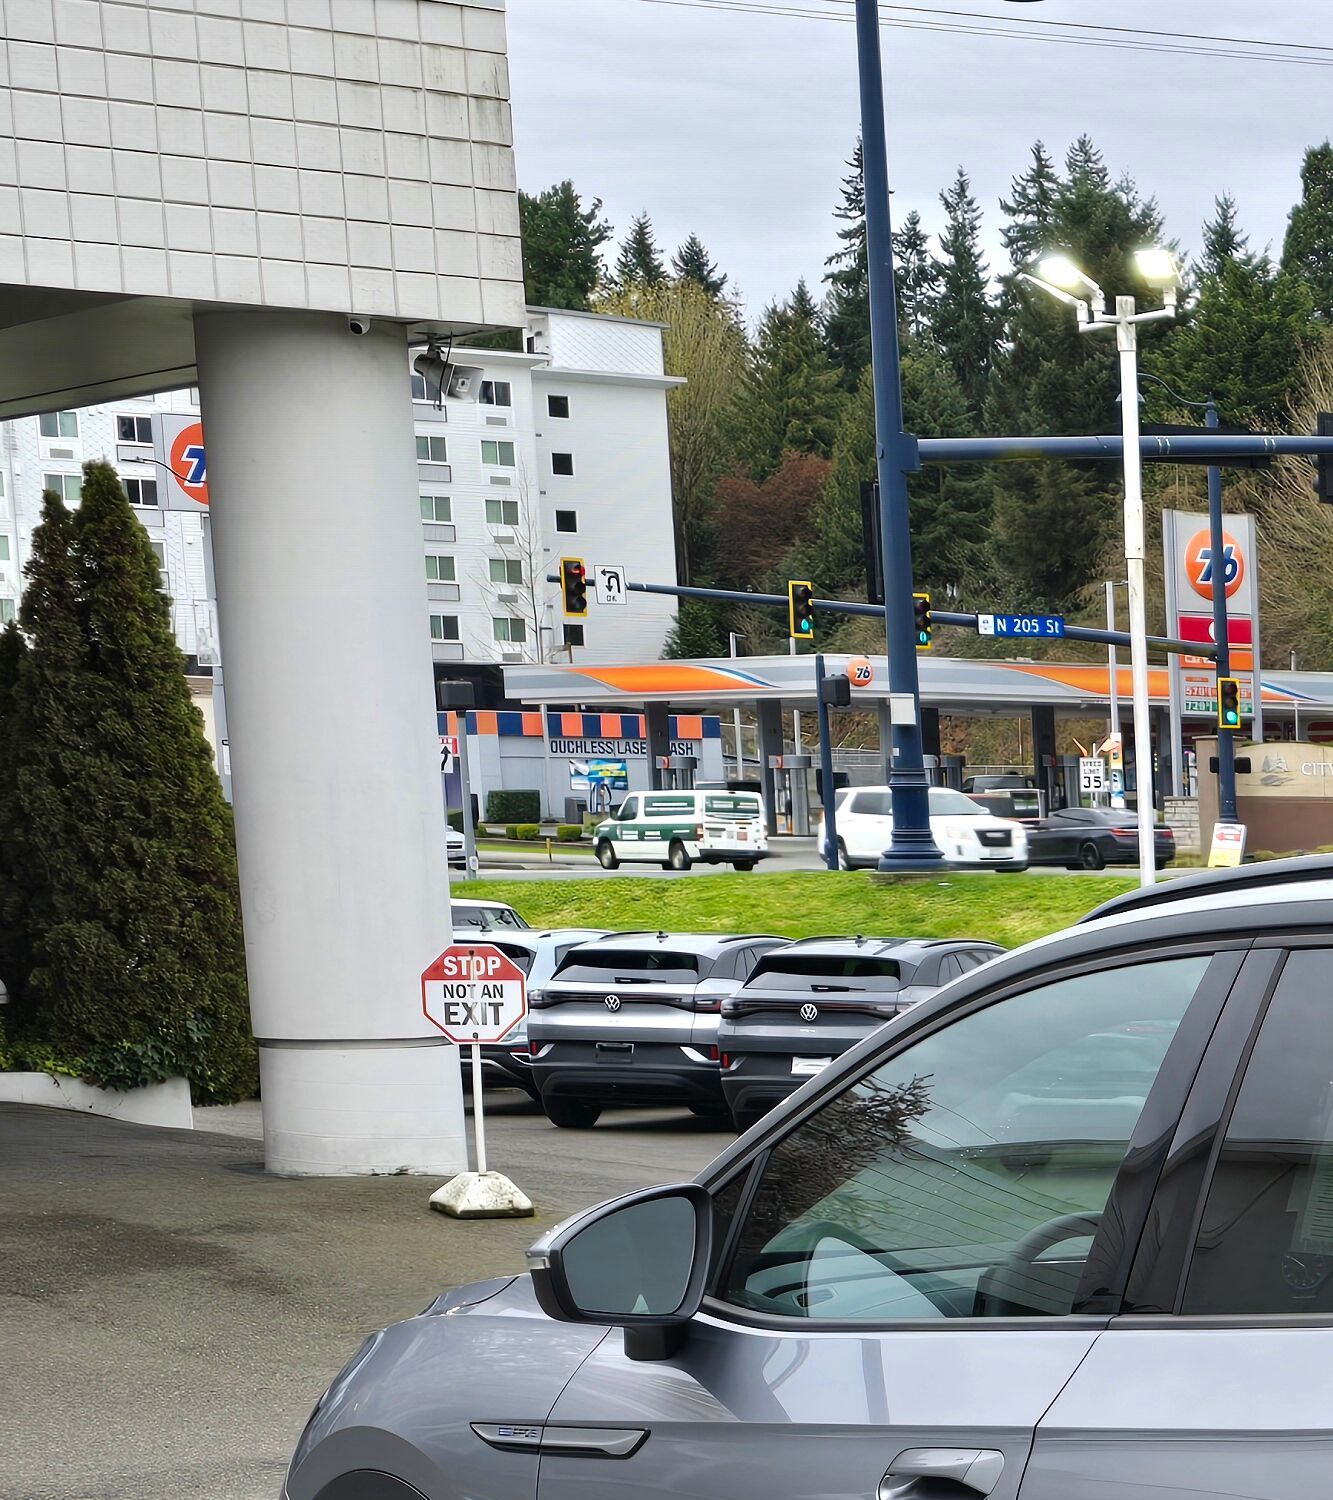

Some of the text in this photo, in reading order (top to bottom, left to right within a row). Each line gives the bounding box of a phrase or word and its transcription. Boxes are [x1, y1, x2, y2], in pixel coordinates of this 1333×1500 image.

[181, 445, 206, 487] 7
[1196, 544, 1239, 585] 76
[997, 618, 1060, 634] N 205 St
[856, 665, 871, 680] 76
[550, 739, 695, 756] OUCHLESS LASE ASH
[1083, 776, 1102, 788] 35
[443, 955, 501, 976] STOP
[443, 984, 504, 998] NOT AN
[443, 1002, 504, 1026] EXIT
